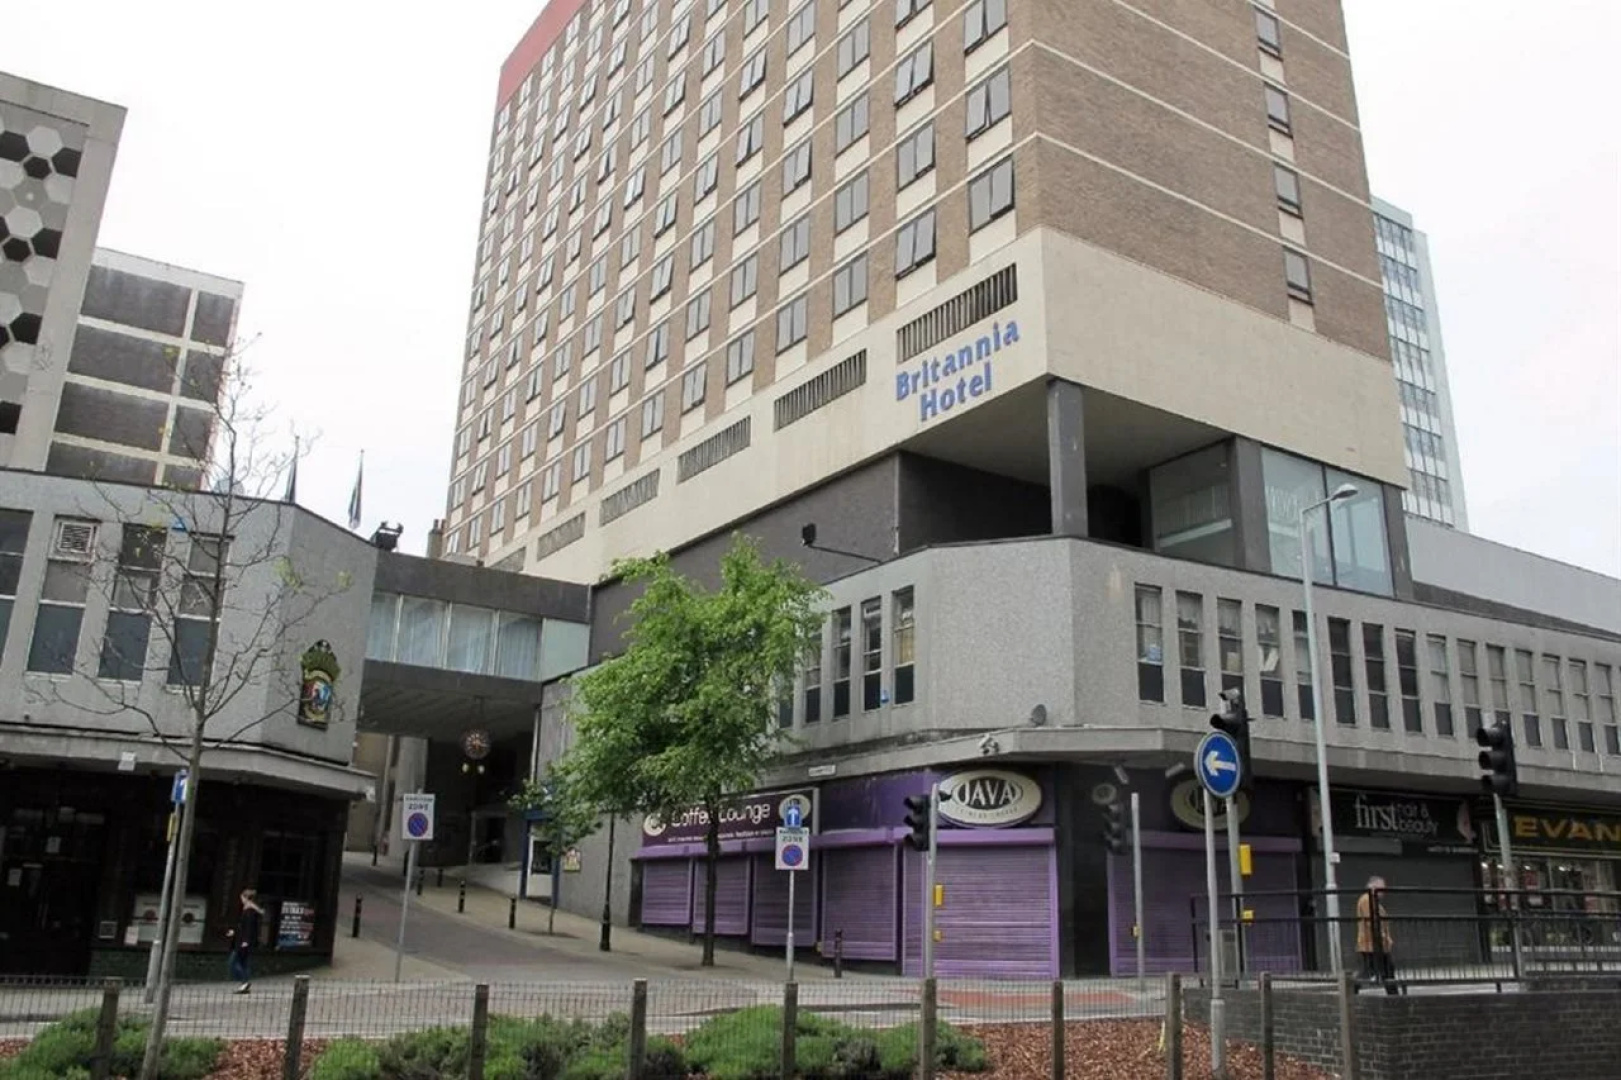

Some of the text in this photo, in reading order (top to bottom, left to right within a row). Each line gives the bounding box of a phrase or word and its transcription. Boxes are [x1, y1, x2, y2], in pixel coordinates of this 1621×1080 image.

[896, 320, 1020, 402] Britannia
[920, 362, 991, 422] Hotel
[957, 778, 1014, 806] JAVA
[718, 803, 771, 825] Lounge
[1354, 793, 1399, 831] first
